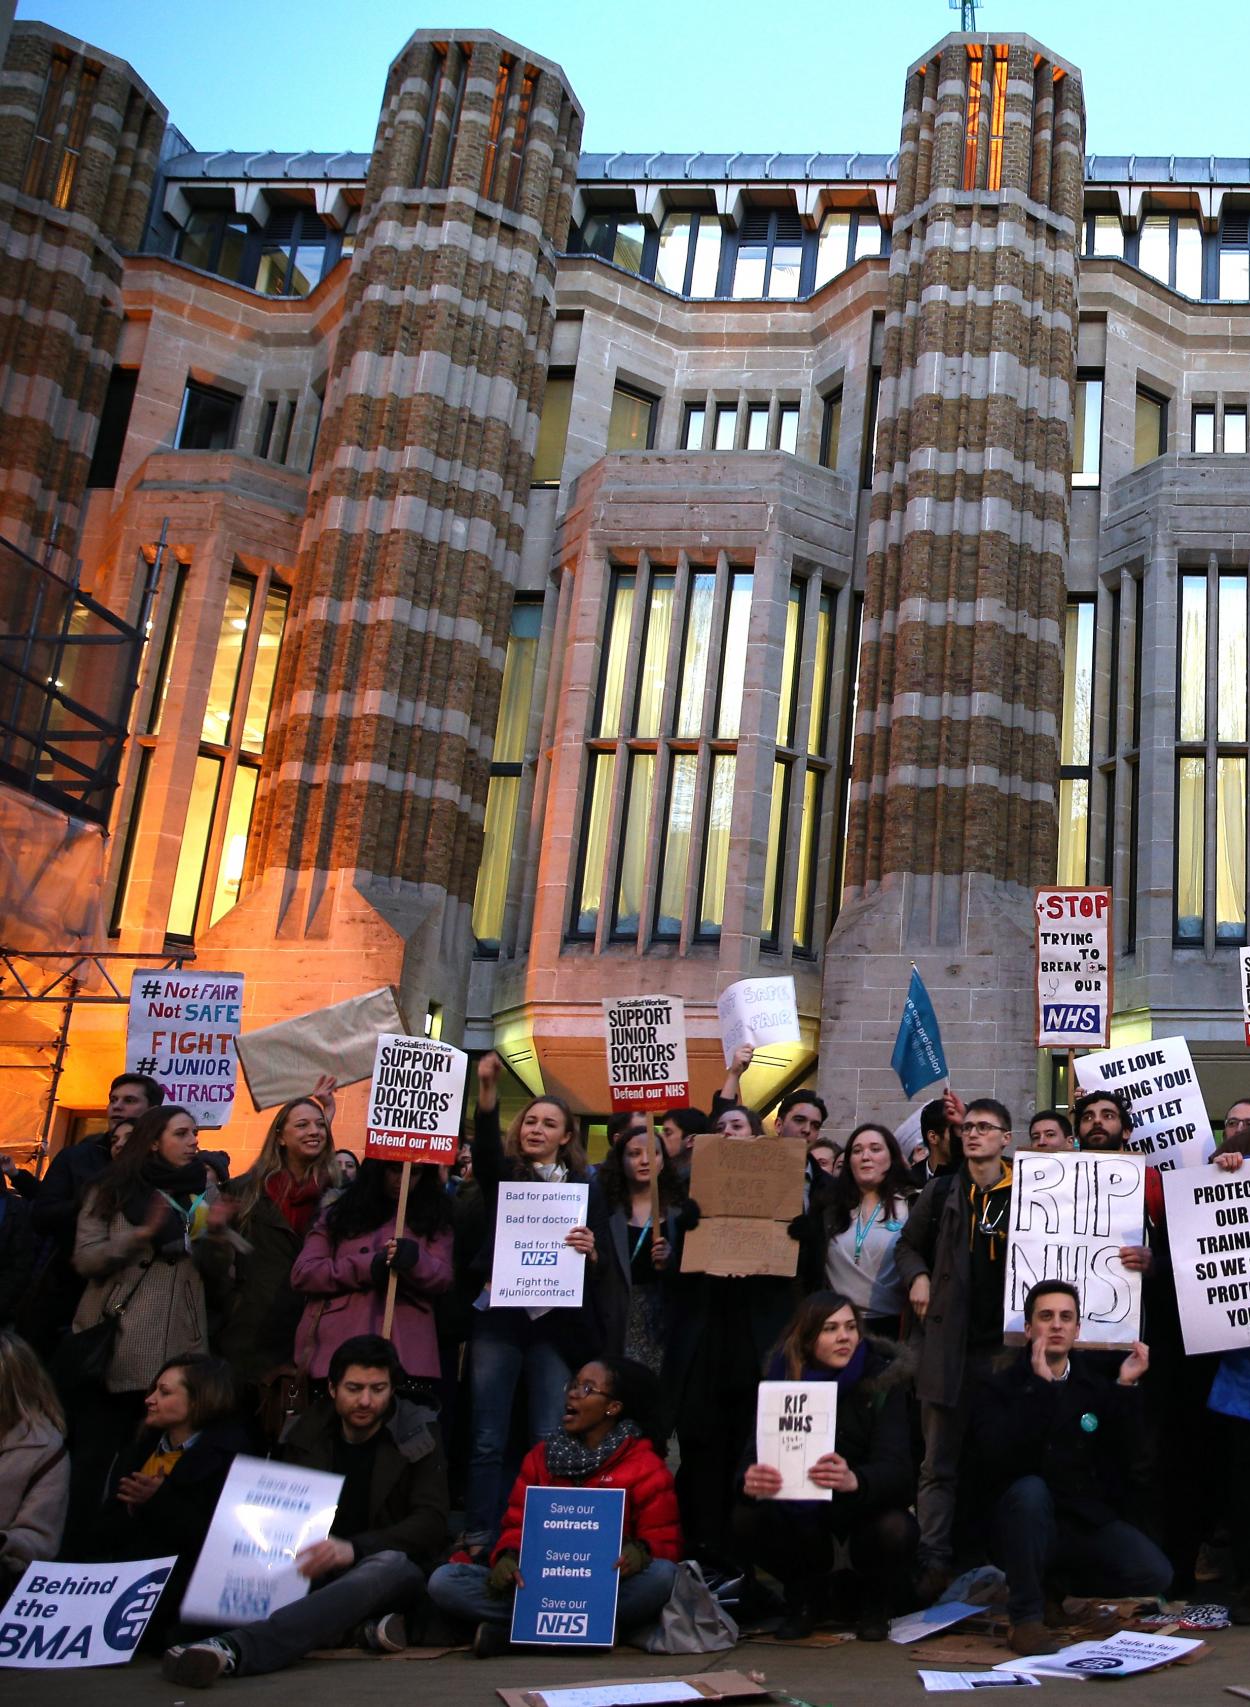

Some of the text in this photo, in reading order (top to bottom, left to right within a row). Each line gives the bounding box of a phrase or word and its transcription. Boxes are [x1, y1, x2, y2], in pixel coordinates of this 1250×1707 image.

[1047, 896, 1109, 919] STOP
[1041, 933, 1093, 945] TRYING
[1079, 949, 1099, 960] TO
[1041, 962, 1081, 972] BREAK
[1075, 980, 1101, 991] OUR
[148, 1003, 239, 1022] Not SAFE
[609, 1007, 672, 1027] SUPPORT
[1046, 1008, 1095, 1030] NHS
[152, 1032, 232, 1054] FIGHT
[611, 1027, 657, 1046] JUNIOR
[913, 1010, 921, 1027] one
[918, 1028, 941, 1074] profession
[381, 1047, 454, 1072] SUPPORT
[612, 1043, 677, 1064] DOCTORS'
[612, 1062, 669, 1082] STRIKES
[1100, 1051, 1166, 1080] WE LOVE
[377, 1067, 433, 1090] JUNIOR
[1153, 1068, 1192, 1091] YOU!
[160, 1083, 234, 1102] NTRACTS
[375, 1087, 453, 1111] DOCTORS'
[614, 1084, 685, 1099] Defend our NHS
[372, 1107, 438, 1130] STRIKES
[1159, 1099, 1182, 1119] LET
[370, 1131, 452, 1151] Defend our NHS
[1156, 1123, 1196, 1150] STOP
[506, 1192, 580, 1201] Bad for patients
[1015, 1157, 1140, 1237] RIP
[506, 1215, 578, 1224] Bad for doctors
[1215, 1207, 1248, 1226] OUR
[523, 1253, 556, 1264] NHS
[1196, 1262, 1217, 1280] SO
[1220, 1257, 1247, 1277] WE
[516, 1278, 541, 1287] Fight
[1011, 1243, 1131, 1323] NHS
[499, 1288, 575, 1297] #juniorcontract
[785, 1394, 807, 1414] RIP
[779, 1415, 812, 1432] NHS
[550, 1503, 595, 1514] Save our
[544, 1520, 599, 1530] contracts
[546, 1550, 591, 1561] Save our
[542, 1566, 592, 1578] patients
[27, 1576, 118, 1595] Behind
[14, 1599, 58, 1618] the
[542, 1598, 587, 1608] Save our
[538, 1614, 585, 1633] NHS
[0, 1622, 93, 1660] BMA
[1157, 1643, 1178, 1651] fair
